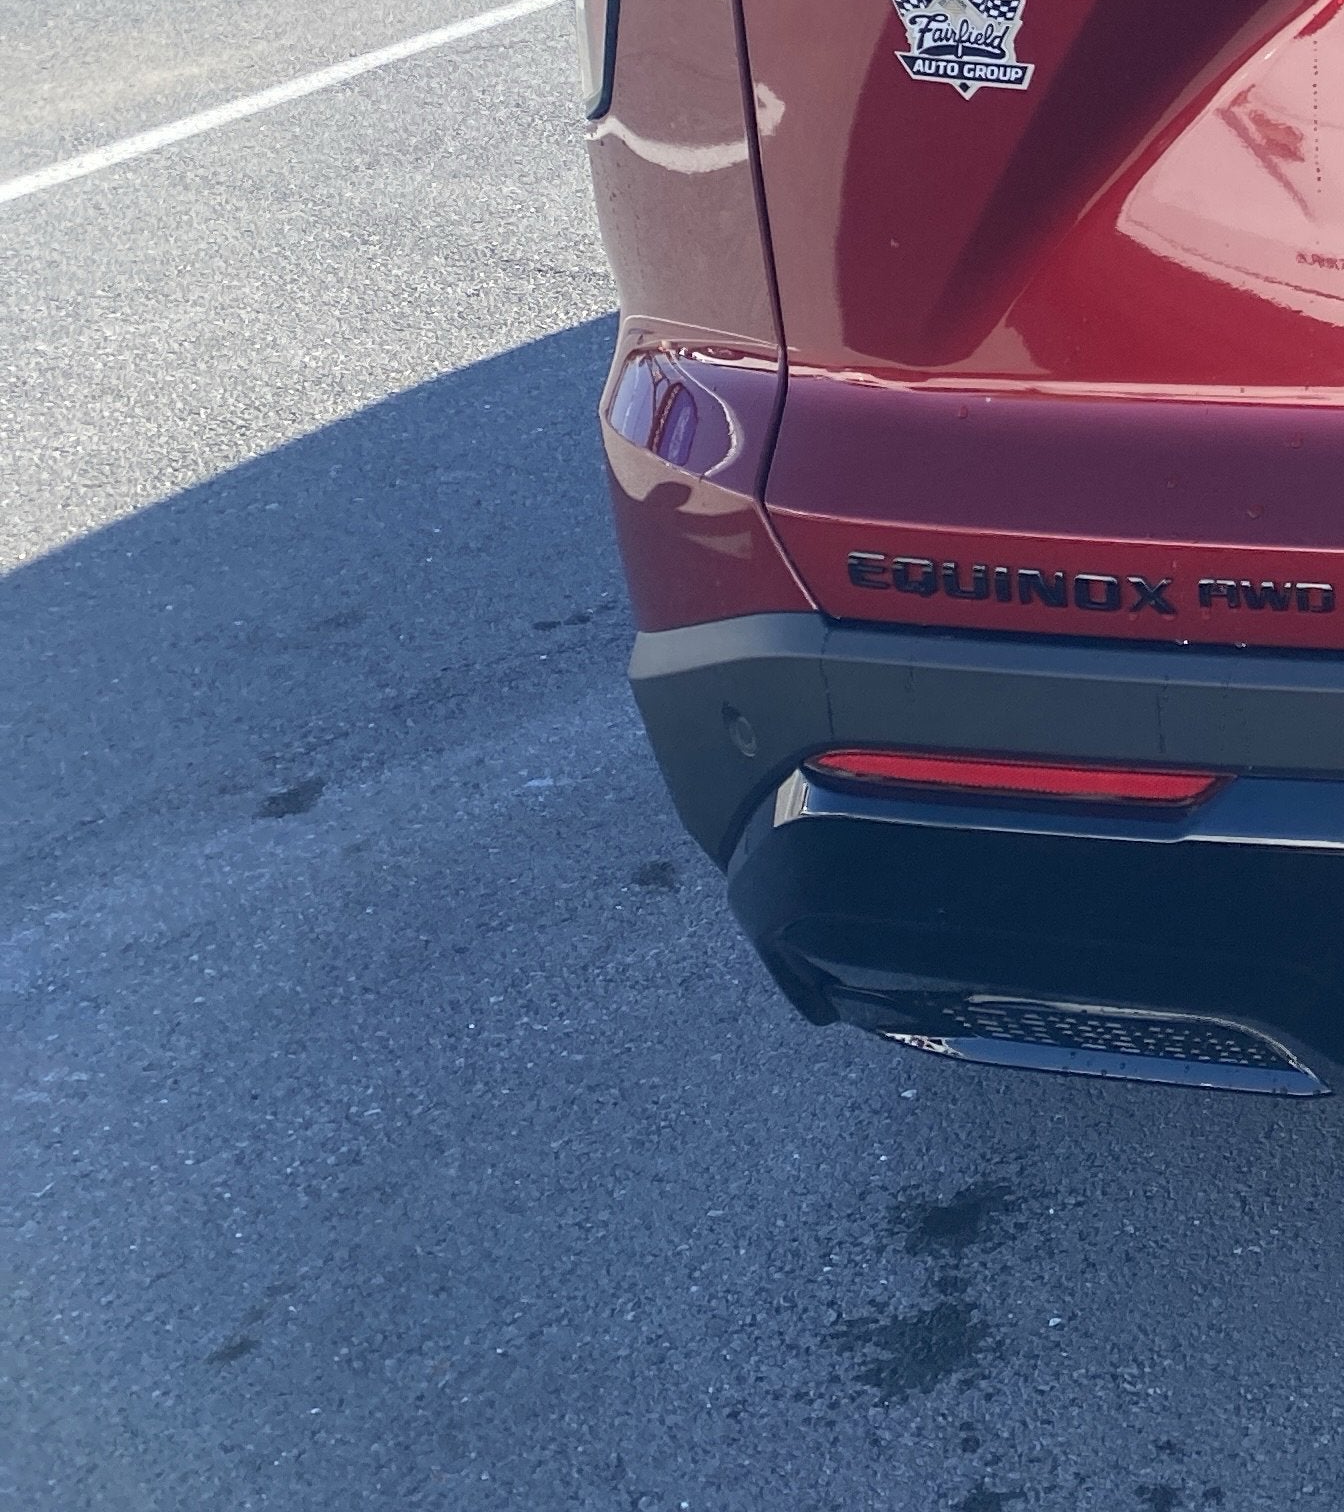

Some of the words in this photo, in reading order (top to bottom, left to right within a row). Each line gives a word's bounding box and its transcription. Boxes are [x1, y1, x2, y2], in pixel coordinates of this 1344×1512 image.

[909, 13, 1009, 59] Fairfield
[913, 59, 956, 76] AUTO
[963, 64, 1023, 81] GROUP
[847, 551, 1177, 616] EQUINOX
[1197, 578, 1336, 614] AWD
